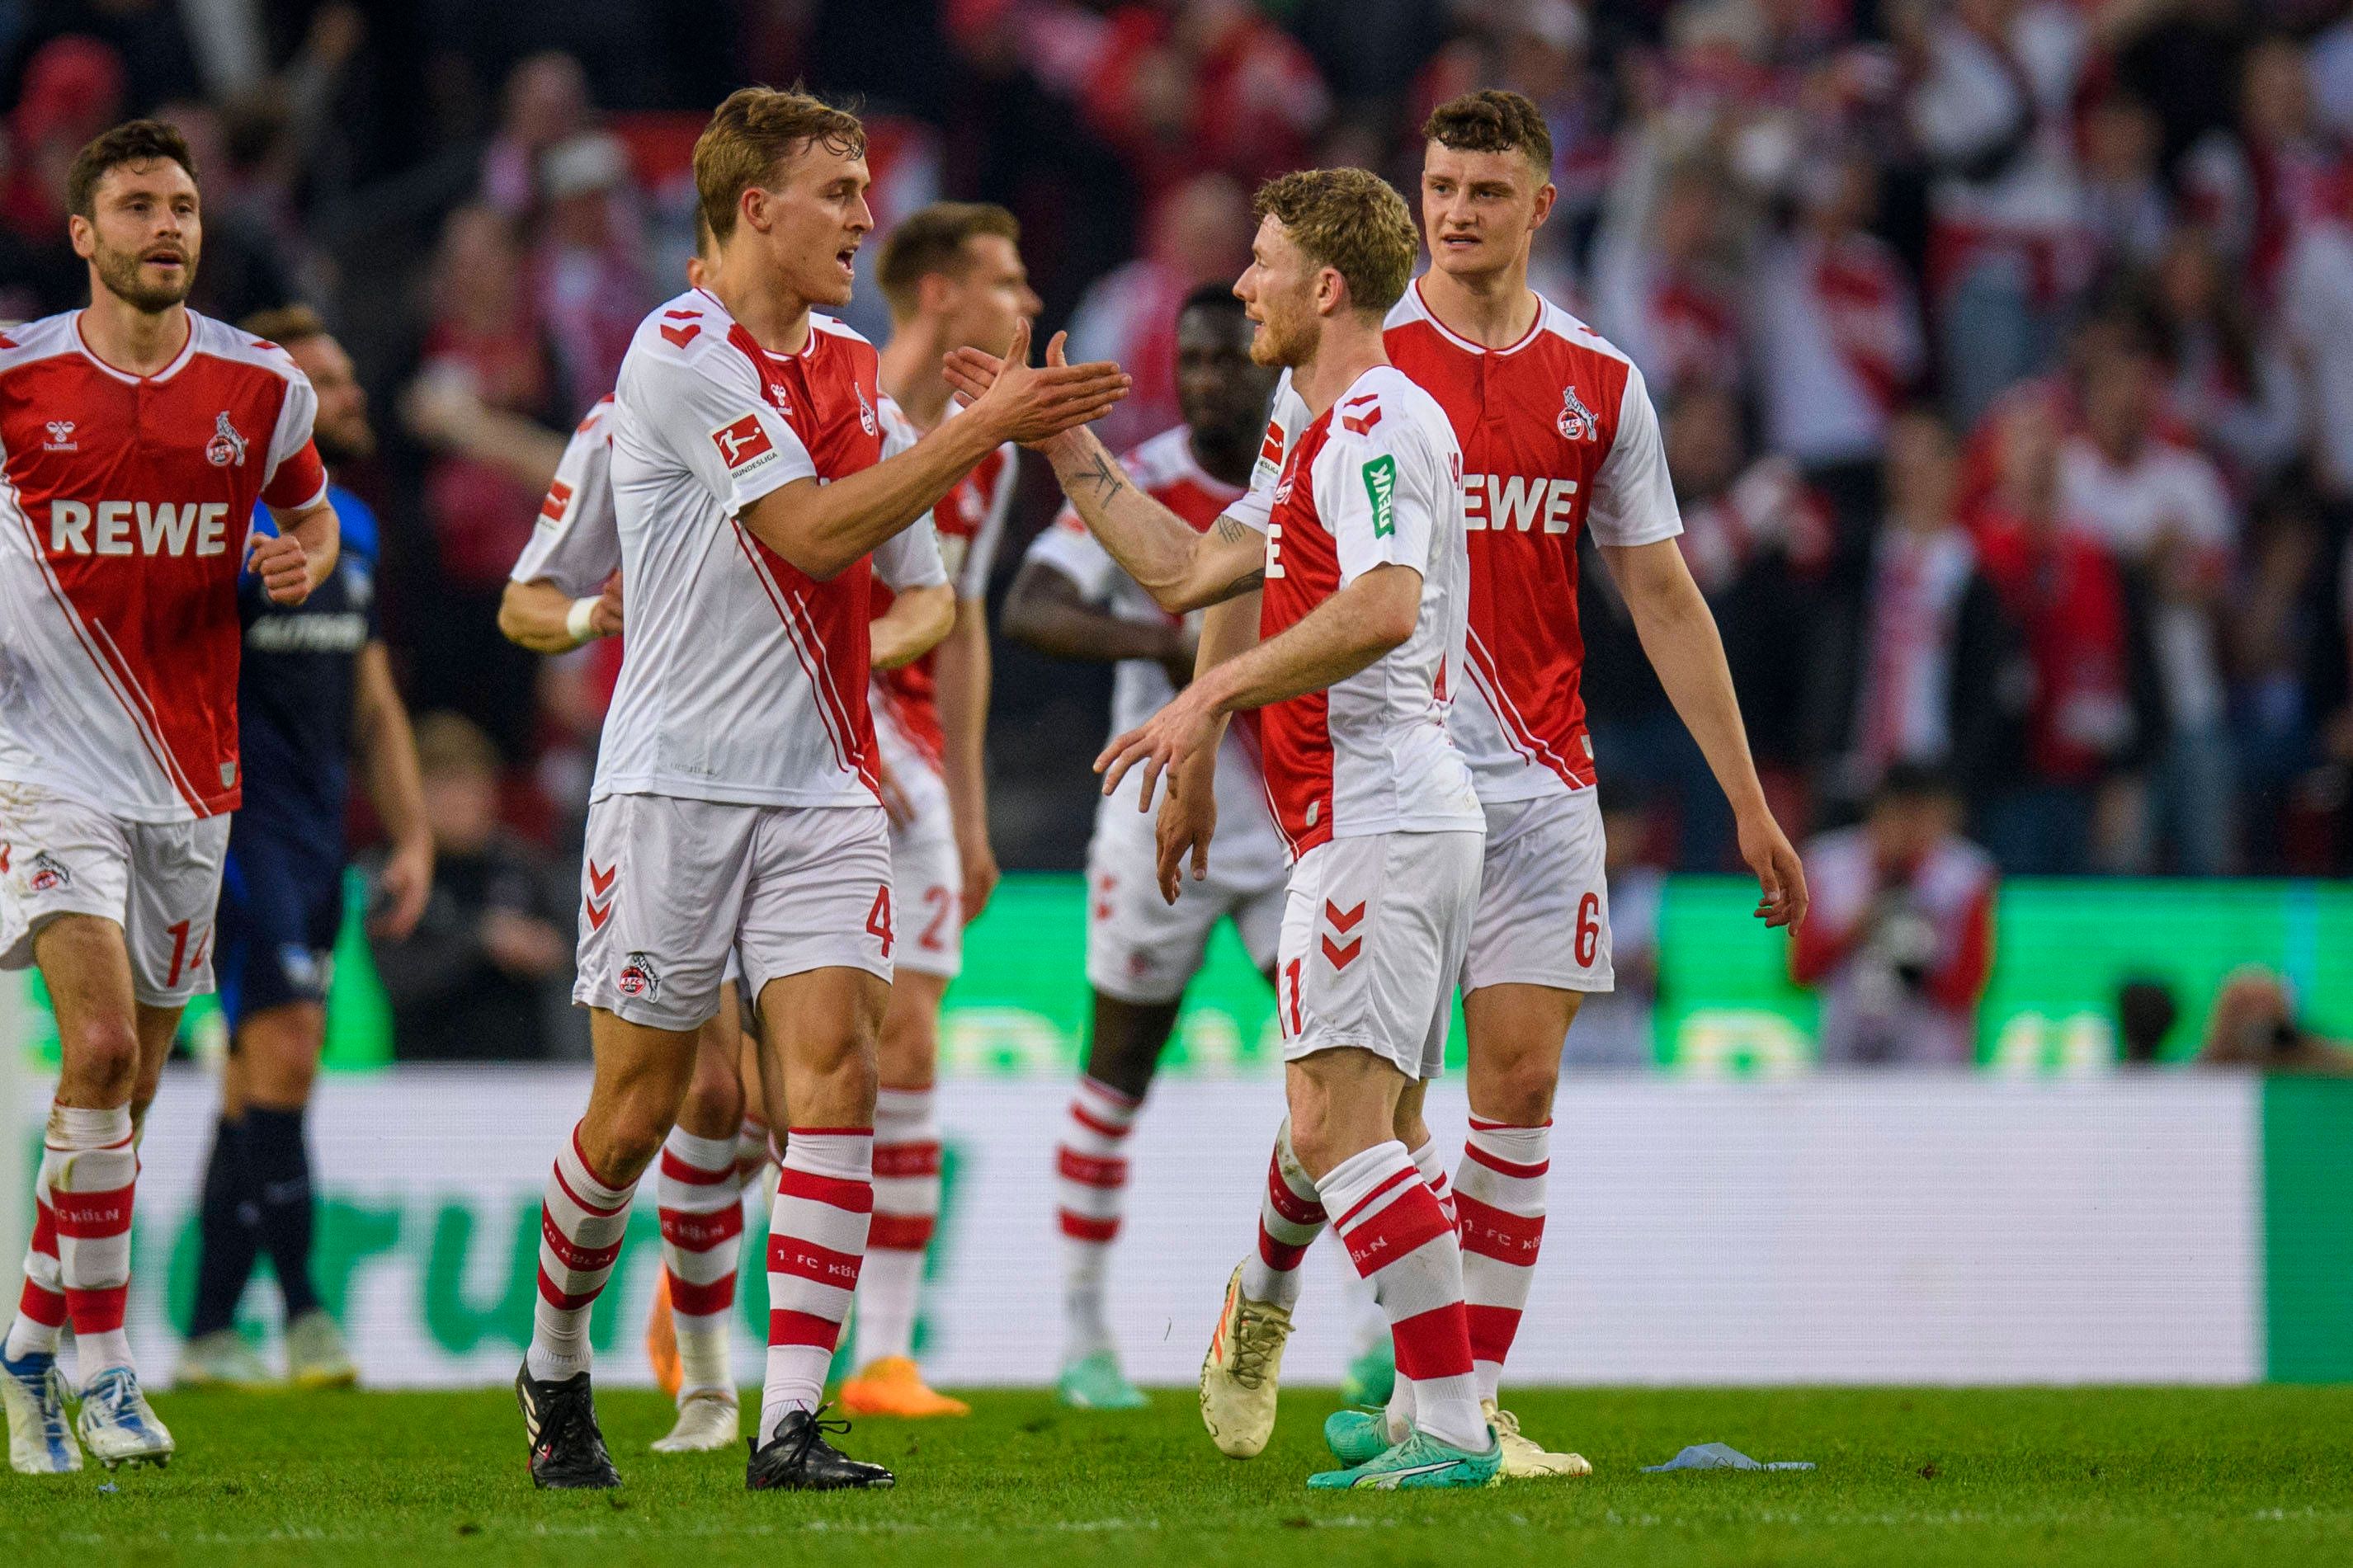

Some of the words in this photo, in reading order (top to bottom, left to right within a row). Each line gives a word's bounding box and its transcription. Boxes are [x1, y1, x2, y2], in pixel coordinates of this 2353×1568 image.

[732, 452, 778, 479] BUNDESLIGA
[1370, 464, 1391, 529] DEVK
[1462, 474, 1577, 534] EWE
[51, 499, 229, 557] REWE
[1265, 523, 1285, 578] E
[866, 884, 894, 959] 4
[1574, 892, 1600, 969] 6
[1276, 958, 1302, 1040] 1
[1353, 1236, 1389, 1264] ÖLN
[1487, 1228, 1511, 1246] FC
[797, 1254, 818, 1269] FC
[828, 1264, 858, 1279] KÖL
